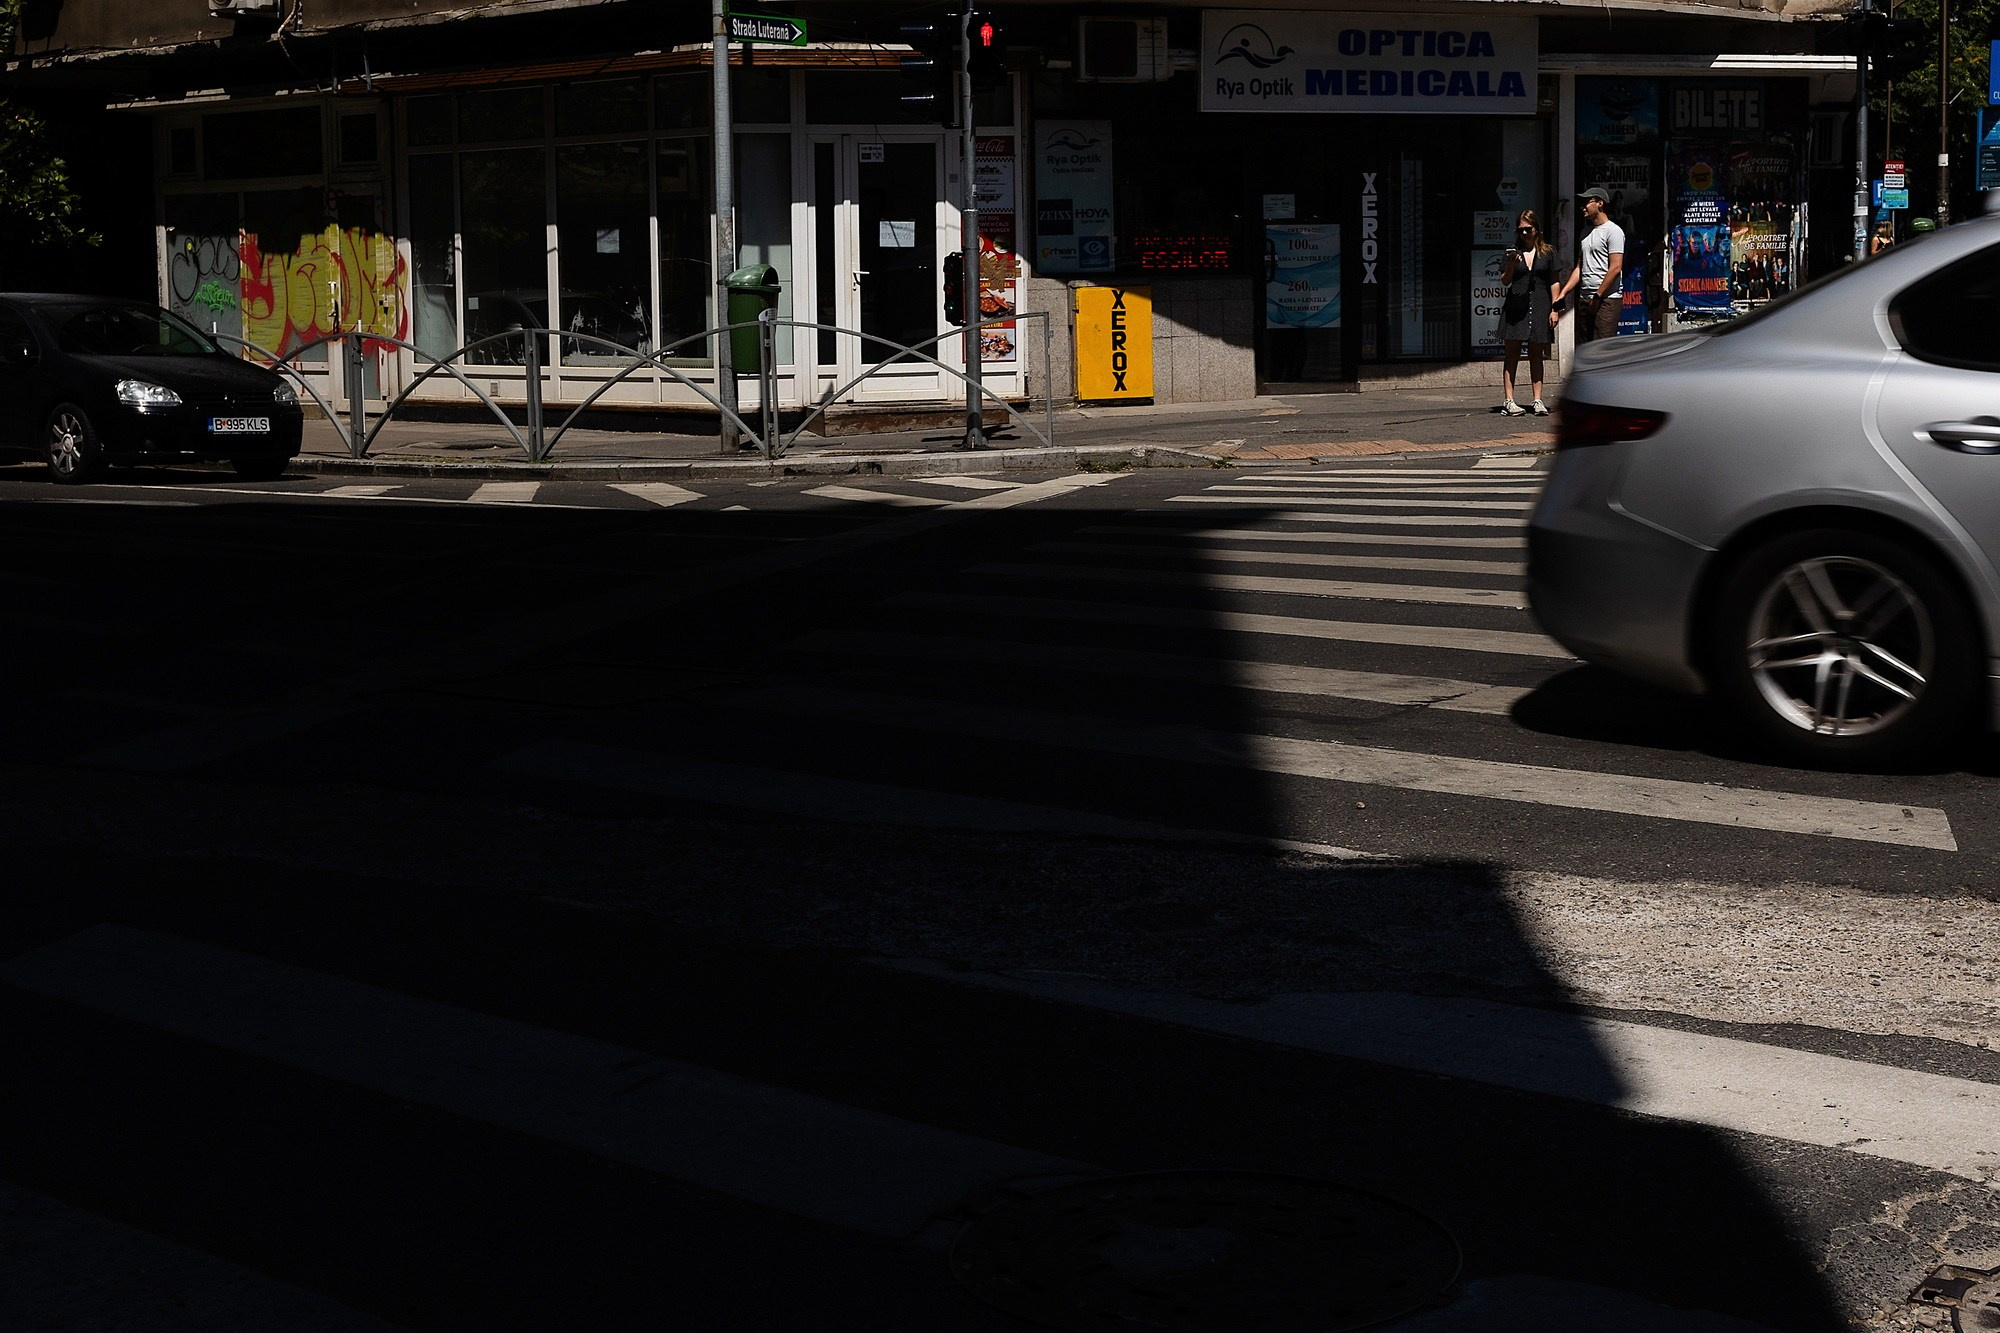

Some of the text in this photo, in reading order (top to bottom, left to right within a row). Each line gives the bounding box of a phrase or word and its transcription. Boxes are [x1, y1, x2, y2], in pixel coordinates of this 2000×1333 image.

[733, 18, 757, 37] Strada
[1338, 29, 1495, 57] OPTICA
[1216, 77, 1294, 100] Rya Optik
[1305, 69, 1526, 97] MEDICALA
[1675, 90, 1760, 128] BILETE
[1047, 154, 1102, 166] Rya Optik
[1039, 210, 1072, 221] ZEISS
[1075, 208, 1111, 218] HOYA
[1362, 172, 1378, 284] XEROX
[1481, 217, 1510, 228] -25%
[1288, 239, 1308, 250] 100
[1752, 234, 1787, 243] PORTRET
[1756, 242, 1787, 250] FAMILIE
[1141, 251, 1228, 269] ESSILOR
[1486, 269, 1499, 277] Rya
[1288, 280, 1308, 292] 260
[1474, 287, 1508, 298] CONSU
[1111, 289, 1128, 392] XEROX
[215, 418, 223, 430] B
[226, 418, 246, 430] 995
[247, 418, 268, 430] KLS
